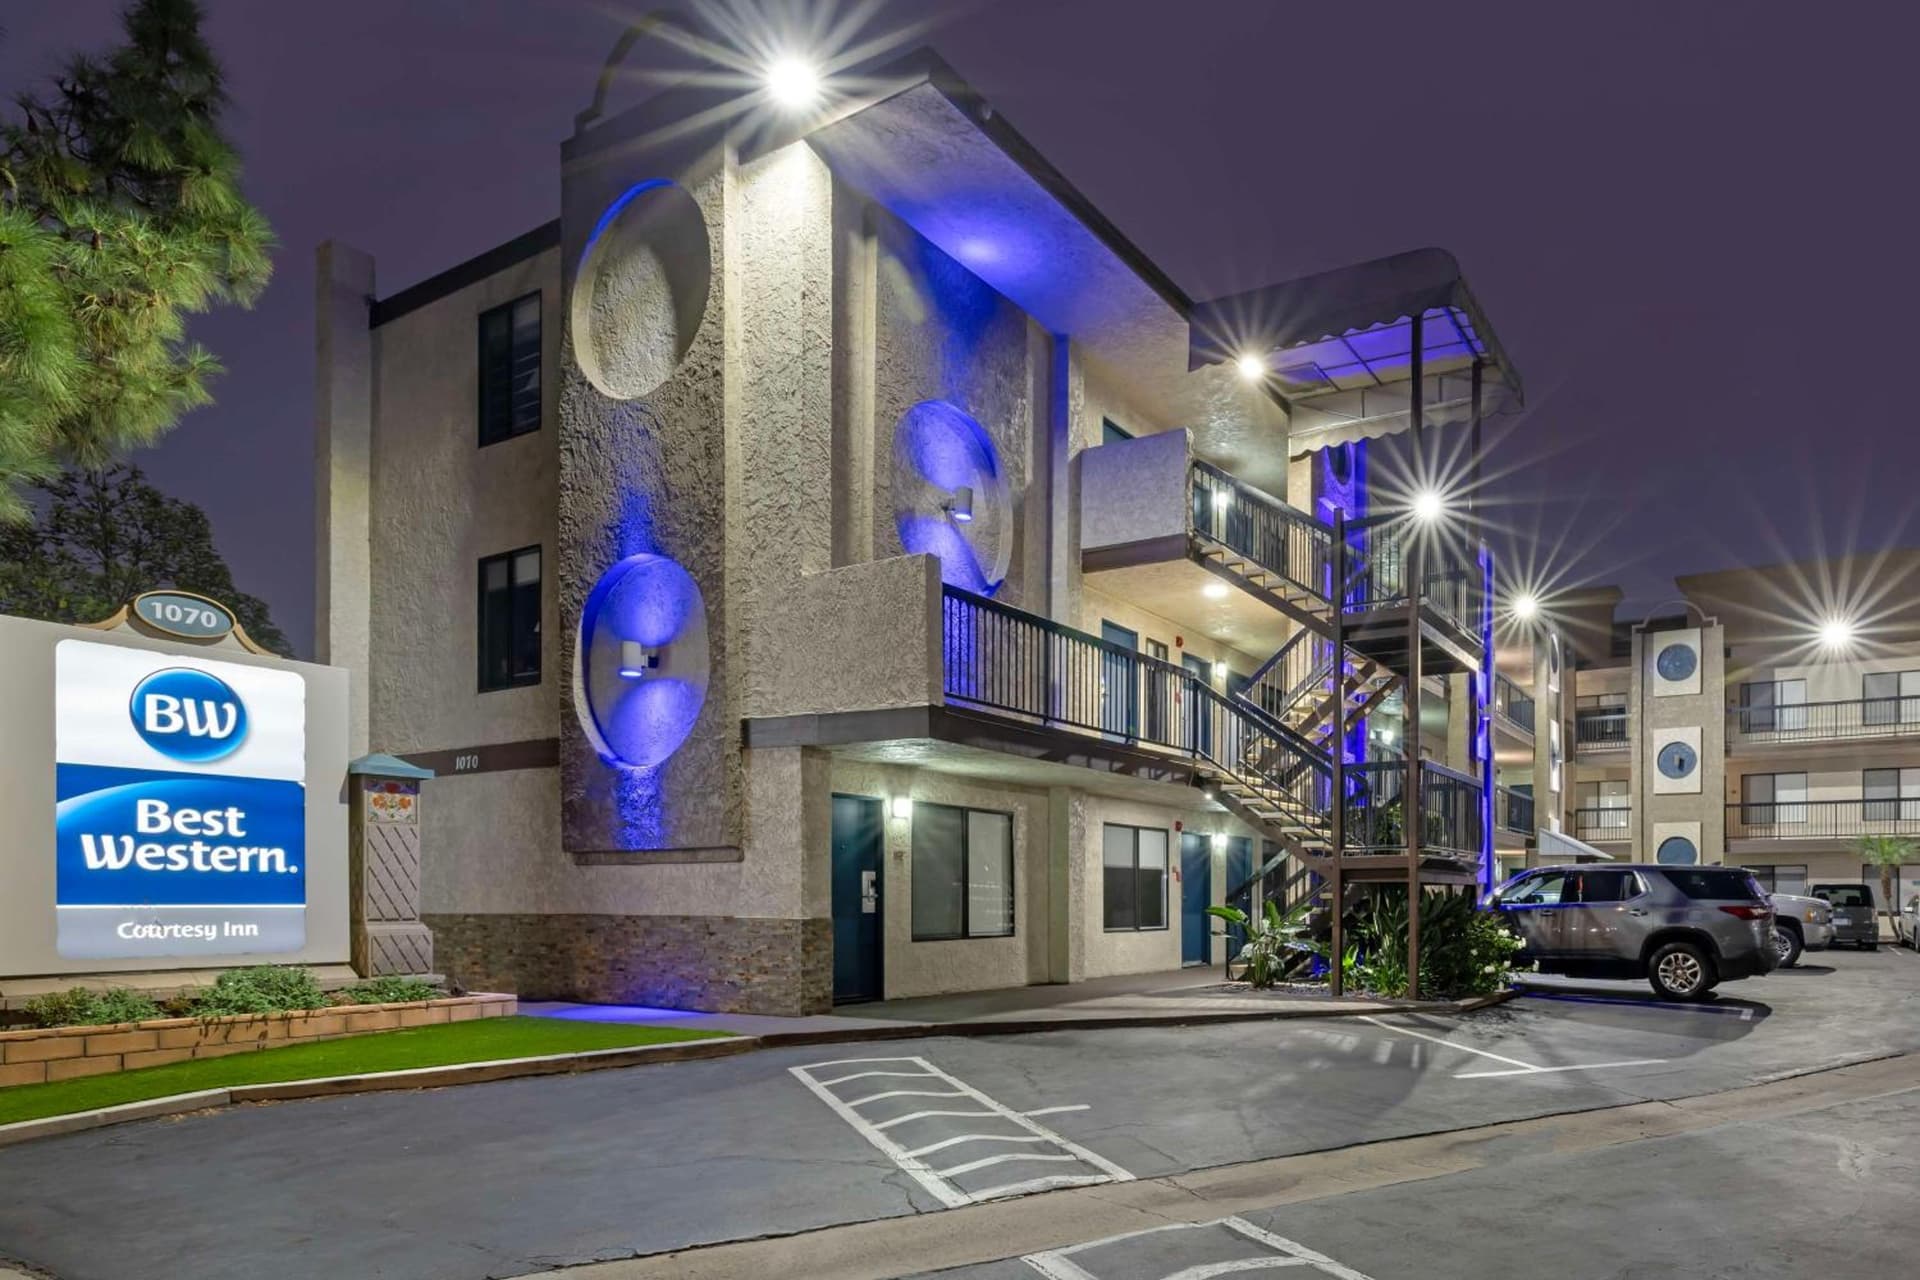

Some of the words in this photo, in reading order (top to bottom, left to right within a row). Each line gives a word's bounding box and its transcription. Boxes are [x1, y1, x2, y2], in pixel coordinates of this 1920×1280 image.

[151, 602, 217, 628] 1070
[145, 694, 236, 739] BW
[137, 800, 246, 837] Best
[117, 920, 217, 941] Courtesy
[223, 921, 259, 937] Inn
